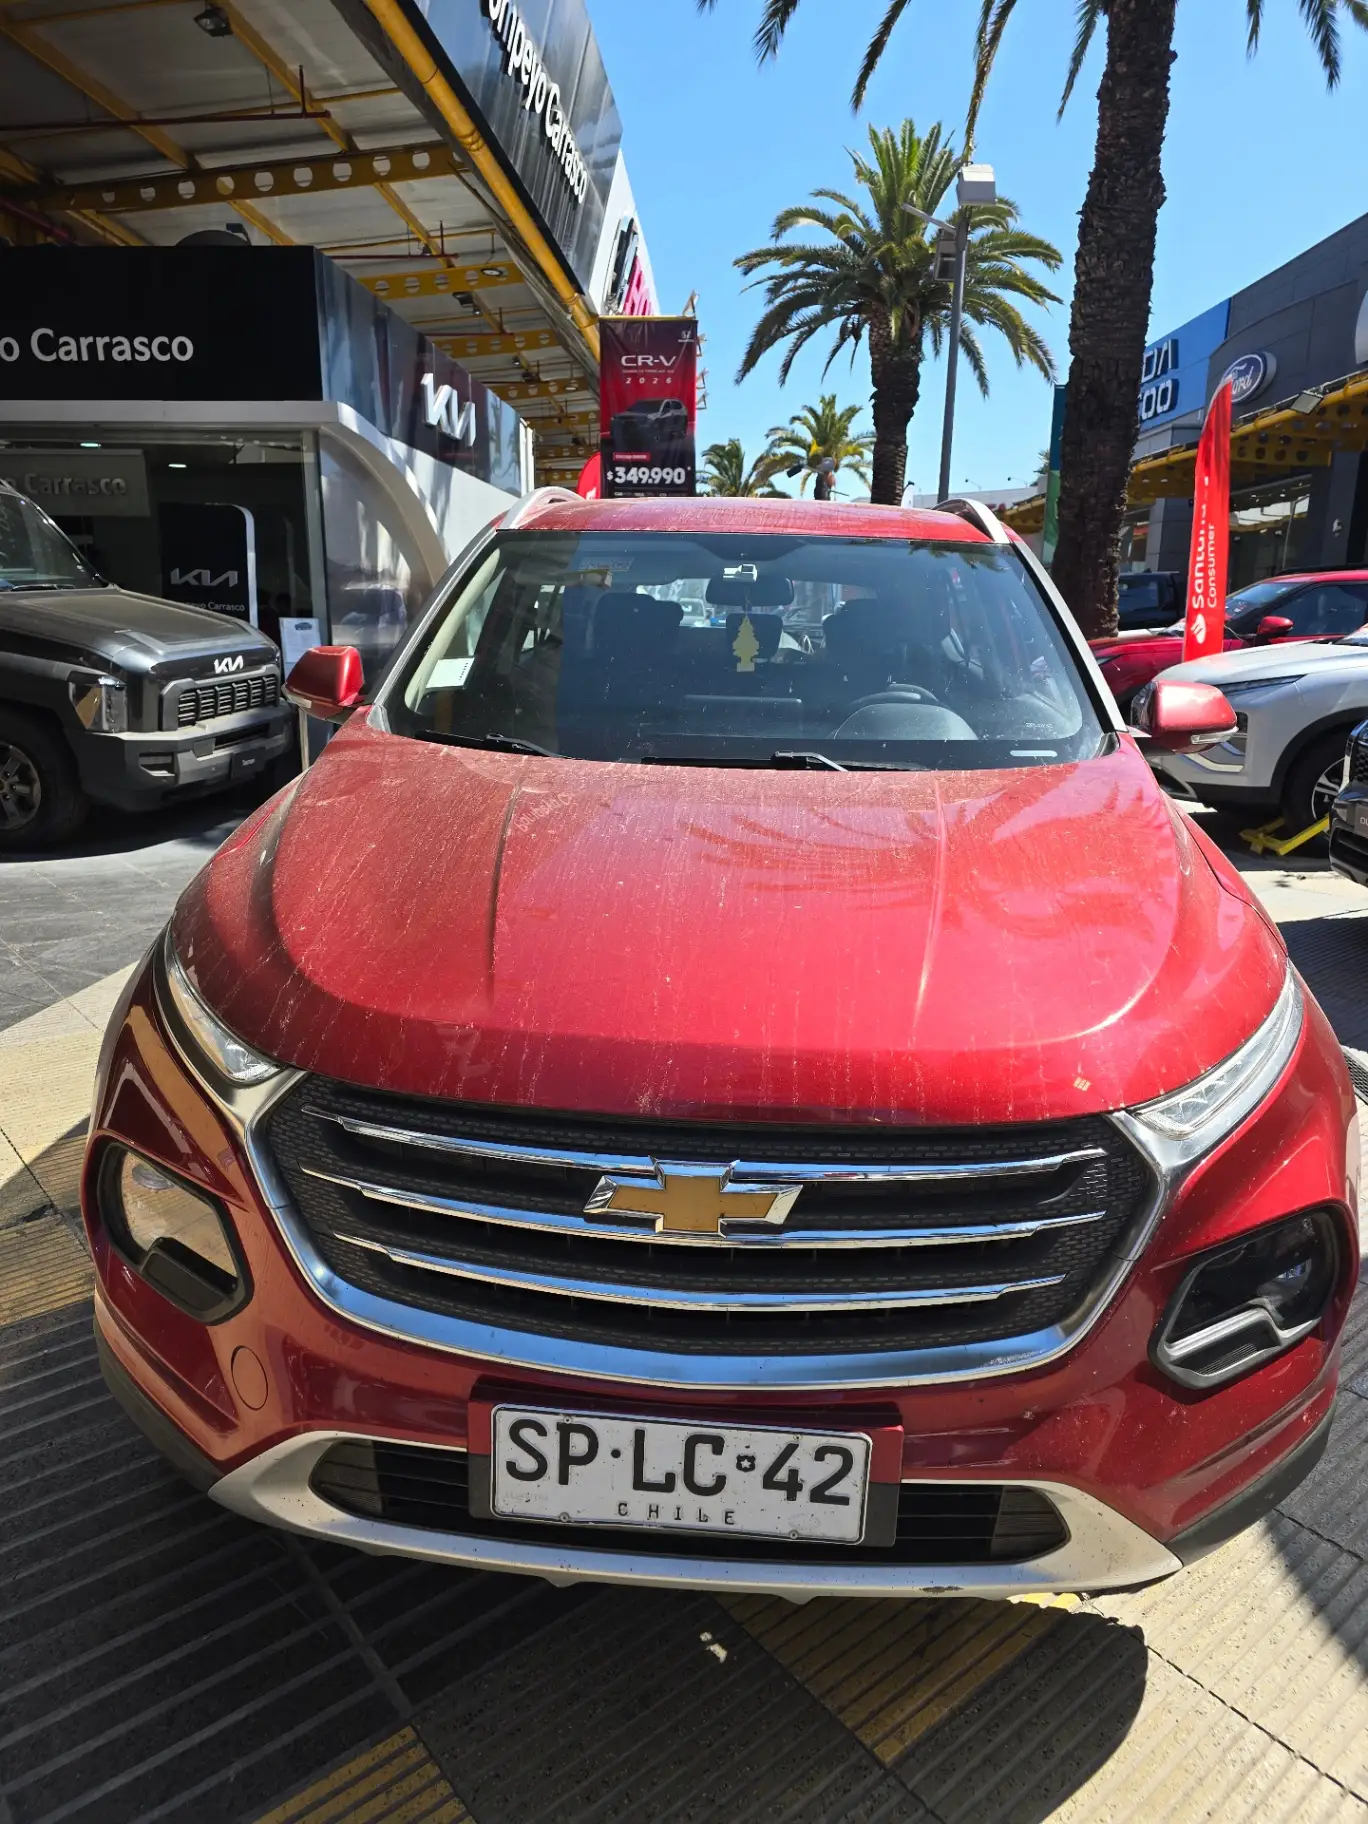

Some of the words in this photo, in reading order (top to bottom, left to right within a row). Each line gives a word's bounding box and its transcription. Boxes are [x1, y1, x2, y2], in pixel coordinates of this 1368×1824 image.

[545, 83, 588, 204] Carrasco
[30, 327, 194, 362] Carrasco
[621, 354, 677, 366] CR-V
[420, 372, 477, 447] KIA
[25, 473, 126, 495] Carrasco
[1207, 523, 1217, 608] Consumer
[170, 567, 238, 588] KIA
[207, 601, 245, 612] Carrasco
[213, 655, 244, 674] KIA
[617, 1502, 735, 1526] CHILE
